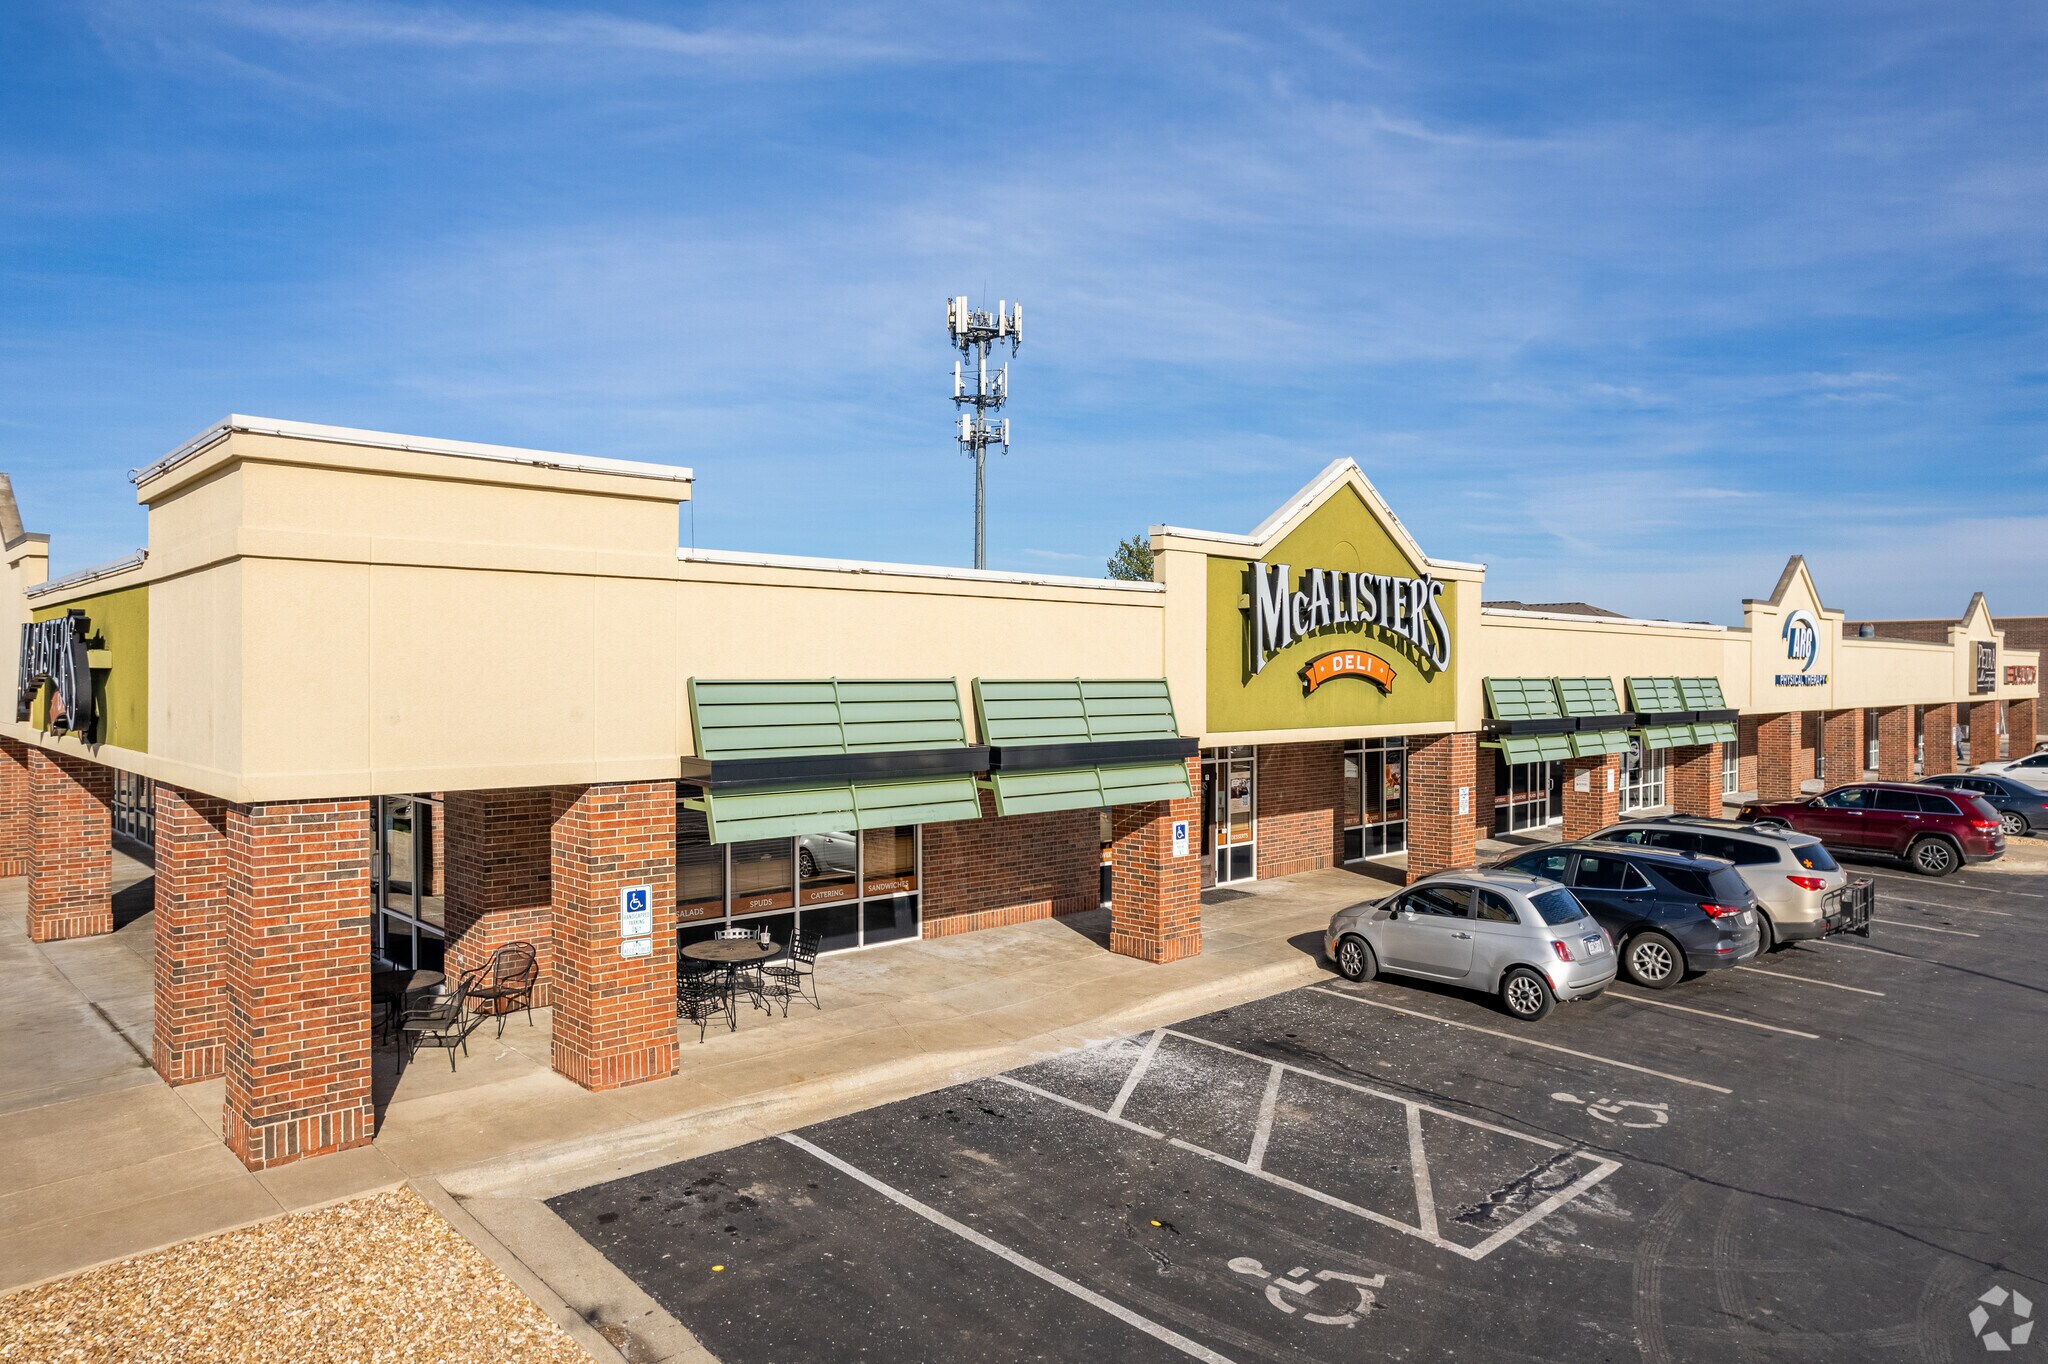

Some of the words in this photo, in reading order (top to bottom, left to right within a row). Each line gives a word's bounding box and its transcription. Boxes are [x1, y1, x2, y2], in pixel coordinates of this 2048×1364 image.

[1251, 561, 1450, 675] McALISTER'S
[1332, 654, 1372, 672] DELI
[1779, 674, 1804, 684] PHYSICAL
[1805, 674, 1826, 684] THERAPY
[868, 880, 909, 892] SANDWICHES
[810, 888, 844, 900] CATERING
[749, 898, 773, 908] SPUDS
[676, 908, 704, 918] SALADS
